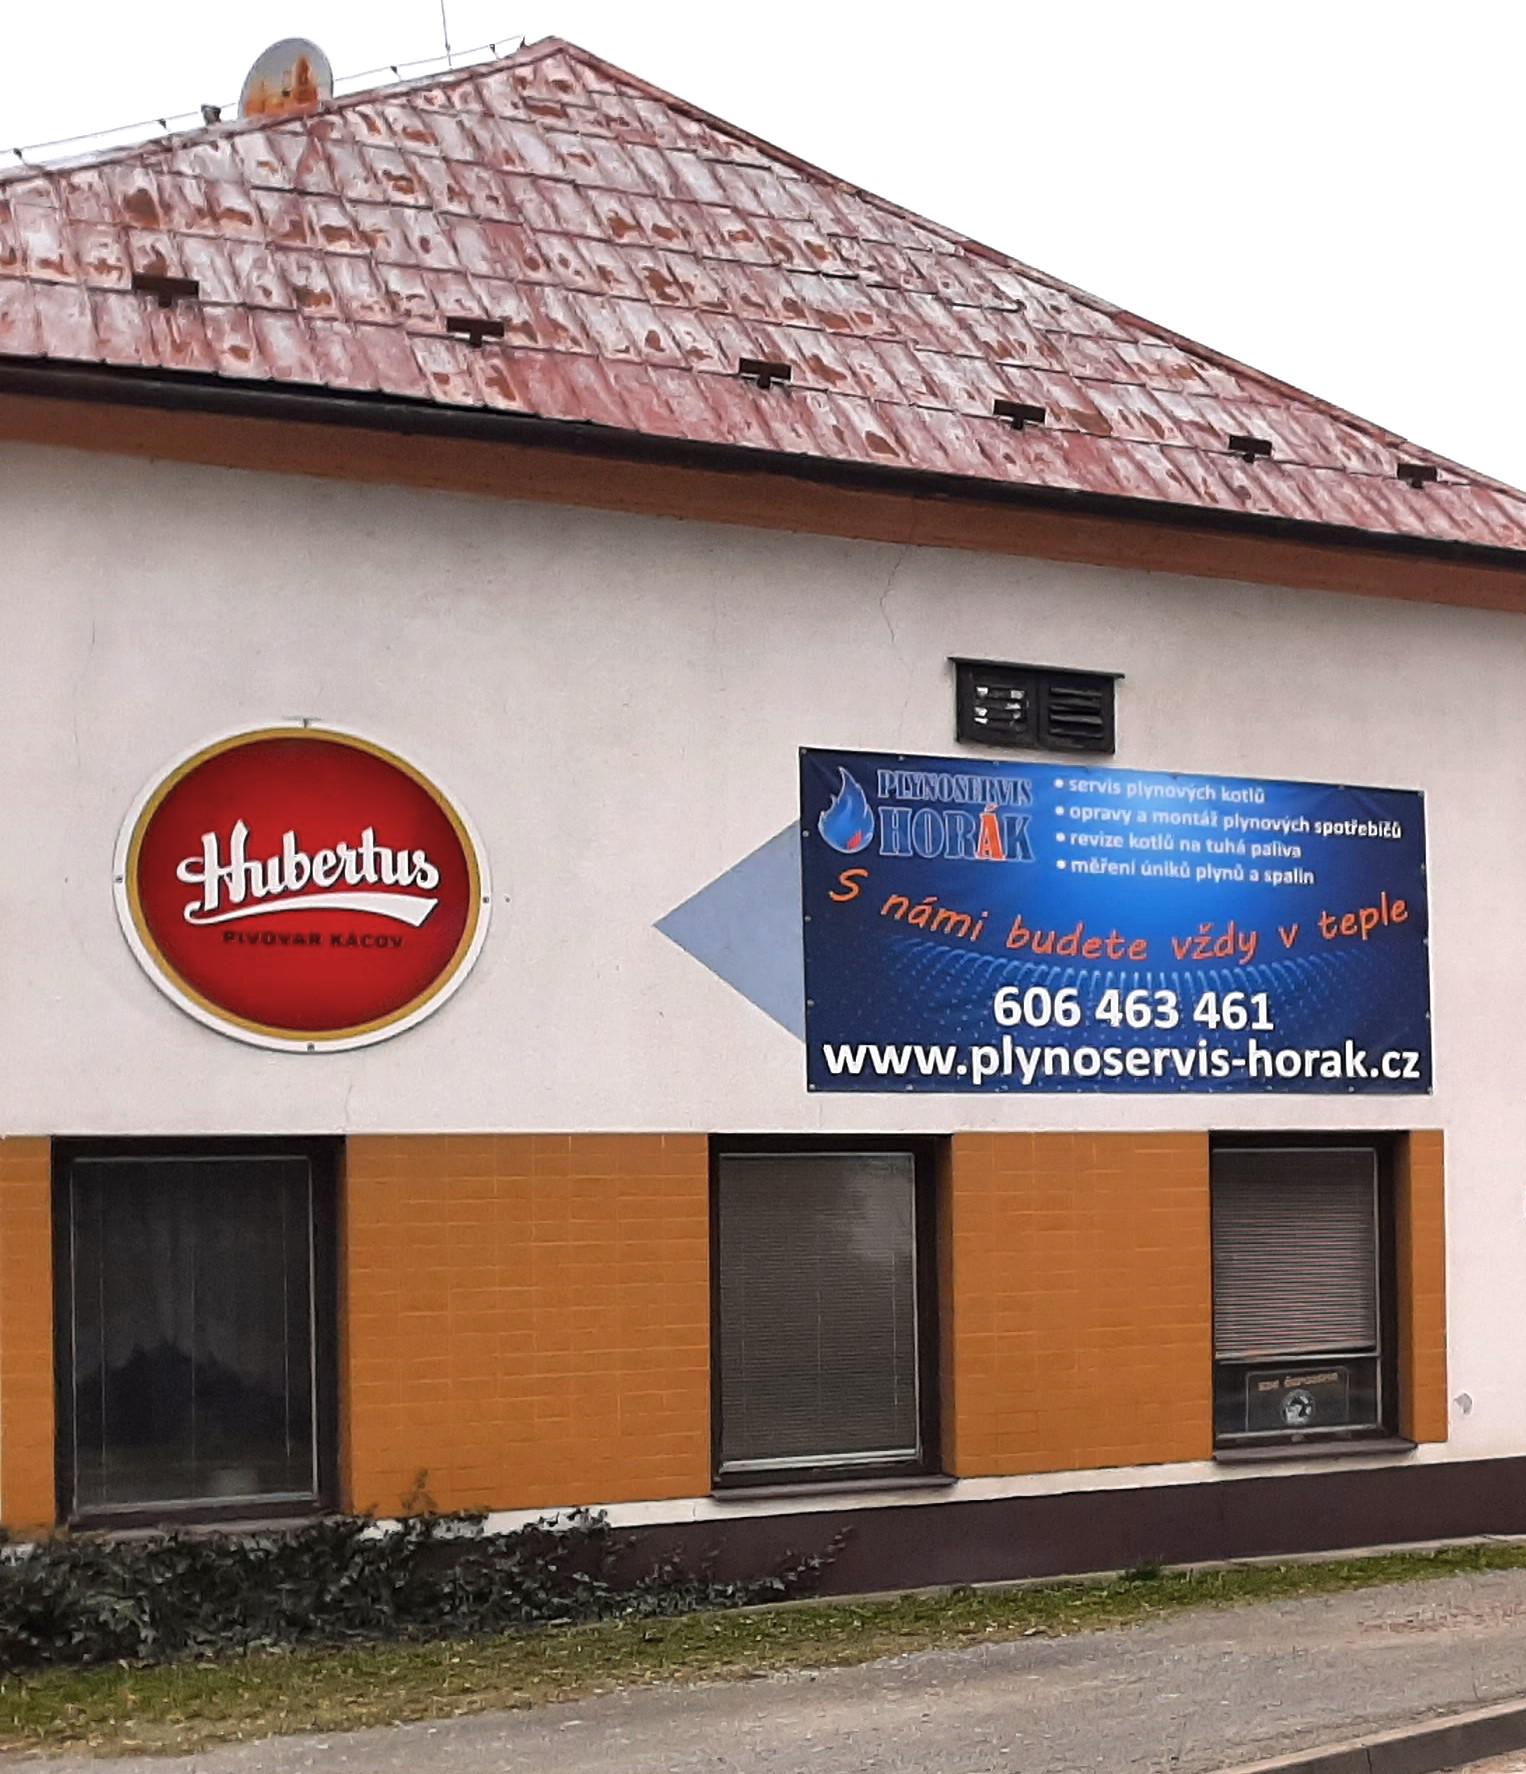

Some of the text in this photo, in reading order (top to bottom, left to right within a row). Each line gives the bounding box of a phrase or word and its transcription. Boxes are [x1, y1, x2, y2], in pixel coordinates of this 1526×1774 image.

[876, 769, 1033, 806] PLYNOSERVIS
[1069, 778, 1265, 804] servis plynových kotlů
[878, 802, 1035, 862] HORÁK
[1070, 806, 1402, 839] opravy a montáž plynových spotřebičů
[1070, 831, 1302, 859] revize kotlů na tuhá paliva
[176, 818, 441, 913] Hubertus
[1071, 858, 1315, 886] měření úniků plynů a spalin
[828, 868, 1409, 965] S námi budete vždy v teple
[223, 930, 403, 948] PIVOVAR KÁCOV
[994, 986, 1274, 1031] 606 463 461
[823, 1034, 1421, 1086] www.plynoservis-horak.cz
